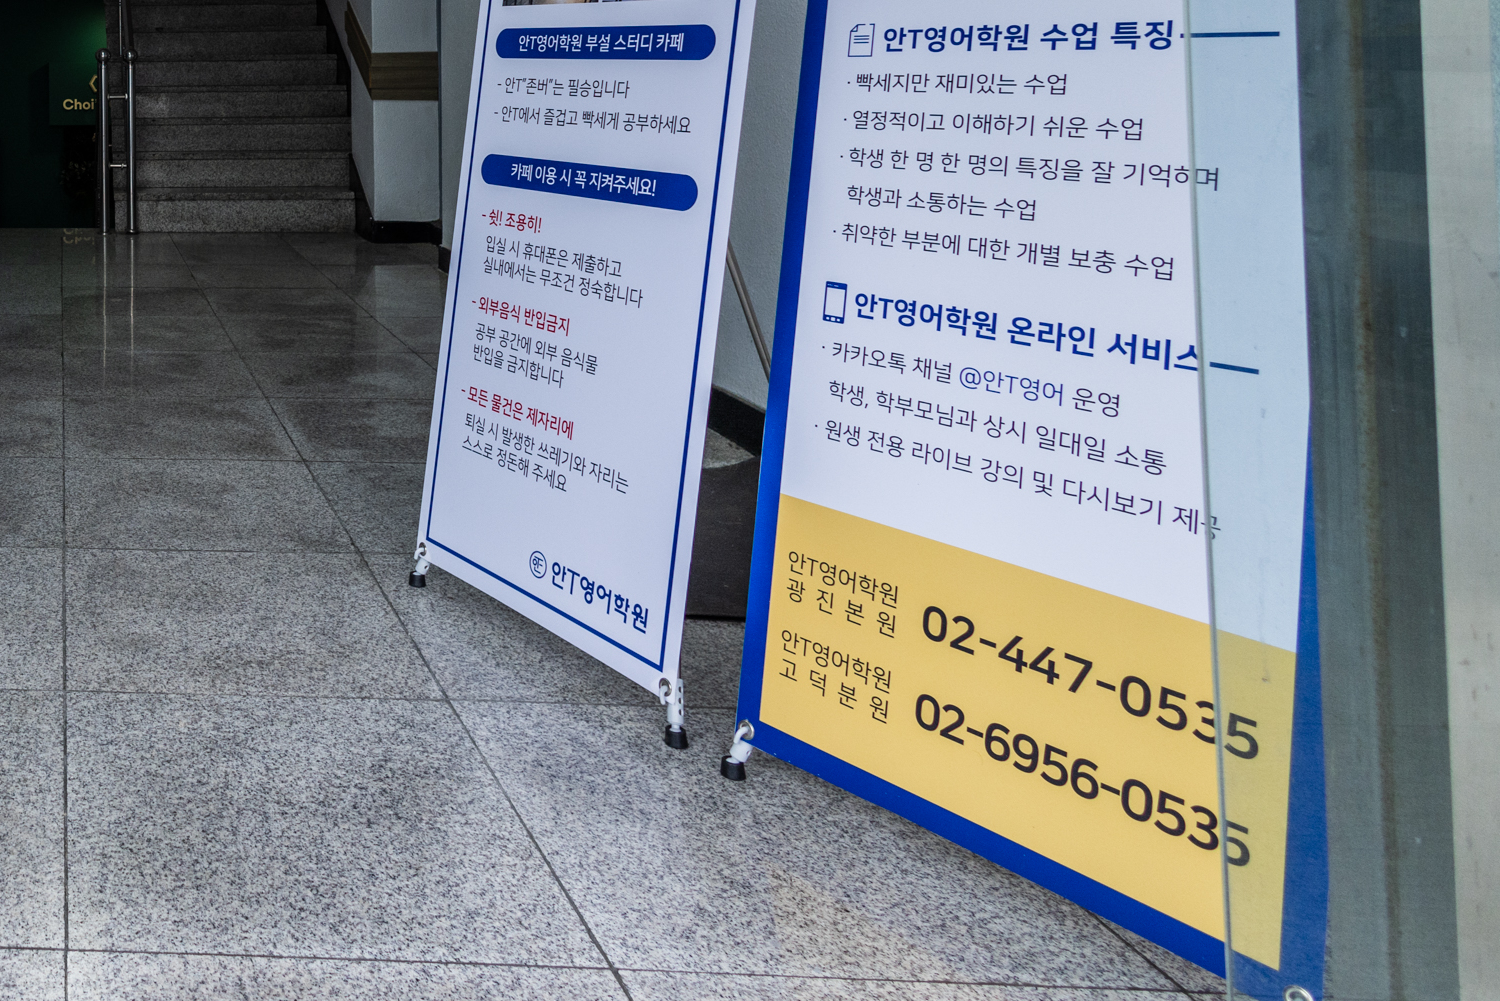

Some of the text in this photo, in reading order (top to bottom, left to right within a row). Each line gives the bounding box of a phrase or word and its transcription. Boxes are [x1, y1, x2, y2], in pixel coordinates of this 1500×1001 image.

[518, 32, 684, 52] 안T영어학원 부설 스터디 카페
[883, 19, 1175, 53] 안T영어학원 수업 특징
[856, 72, 1068, 96] 빡세지만 재미있는 수업
[501, 105, 691, 135] 안T에서 즐겁고 빡세게 공부하세요
[852, 109, 1145, 141] 열정적이고 이해하기 쉬운 수업
[511, 163, 656, 197] 카페 이용 꼭 지켜주세요!
[504, 212, 542, 233] 조용히!
[483, 256, 644, 309] 실내에서는 무조건 정숙합니다
[478, 296, 571, 337] 외부음식 반입금지
[854, 293, 1198, 372] 안T영어학원 온라인 서비스
[832, 341, 1121, 418] 카카오톡 채널 @안T영어 운영
[467, 385, 575, 441] 모든 물건은 제자리에
[828, 380, 1167, 476] 학생, 학부모님과 상시 일대일 소통
[551, 560, 649, 635] 안T영어학원
[922, 605, 1259, 760] 02-447-0535
[915, 693, 1251, 867] 02-6956-0535
